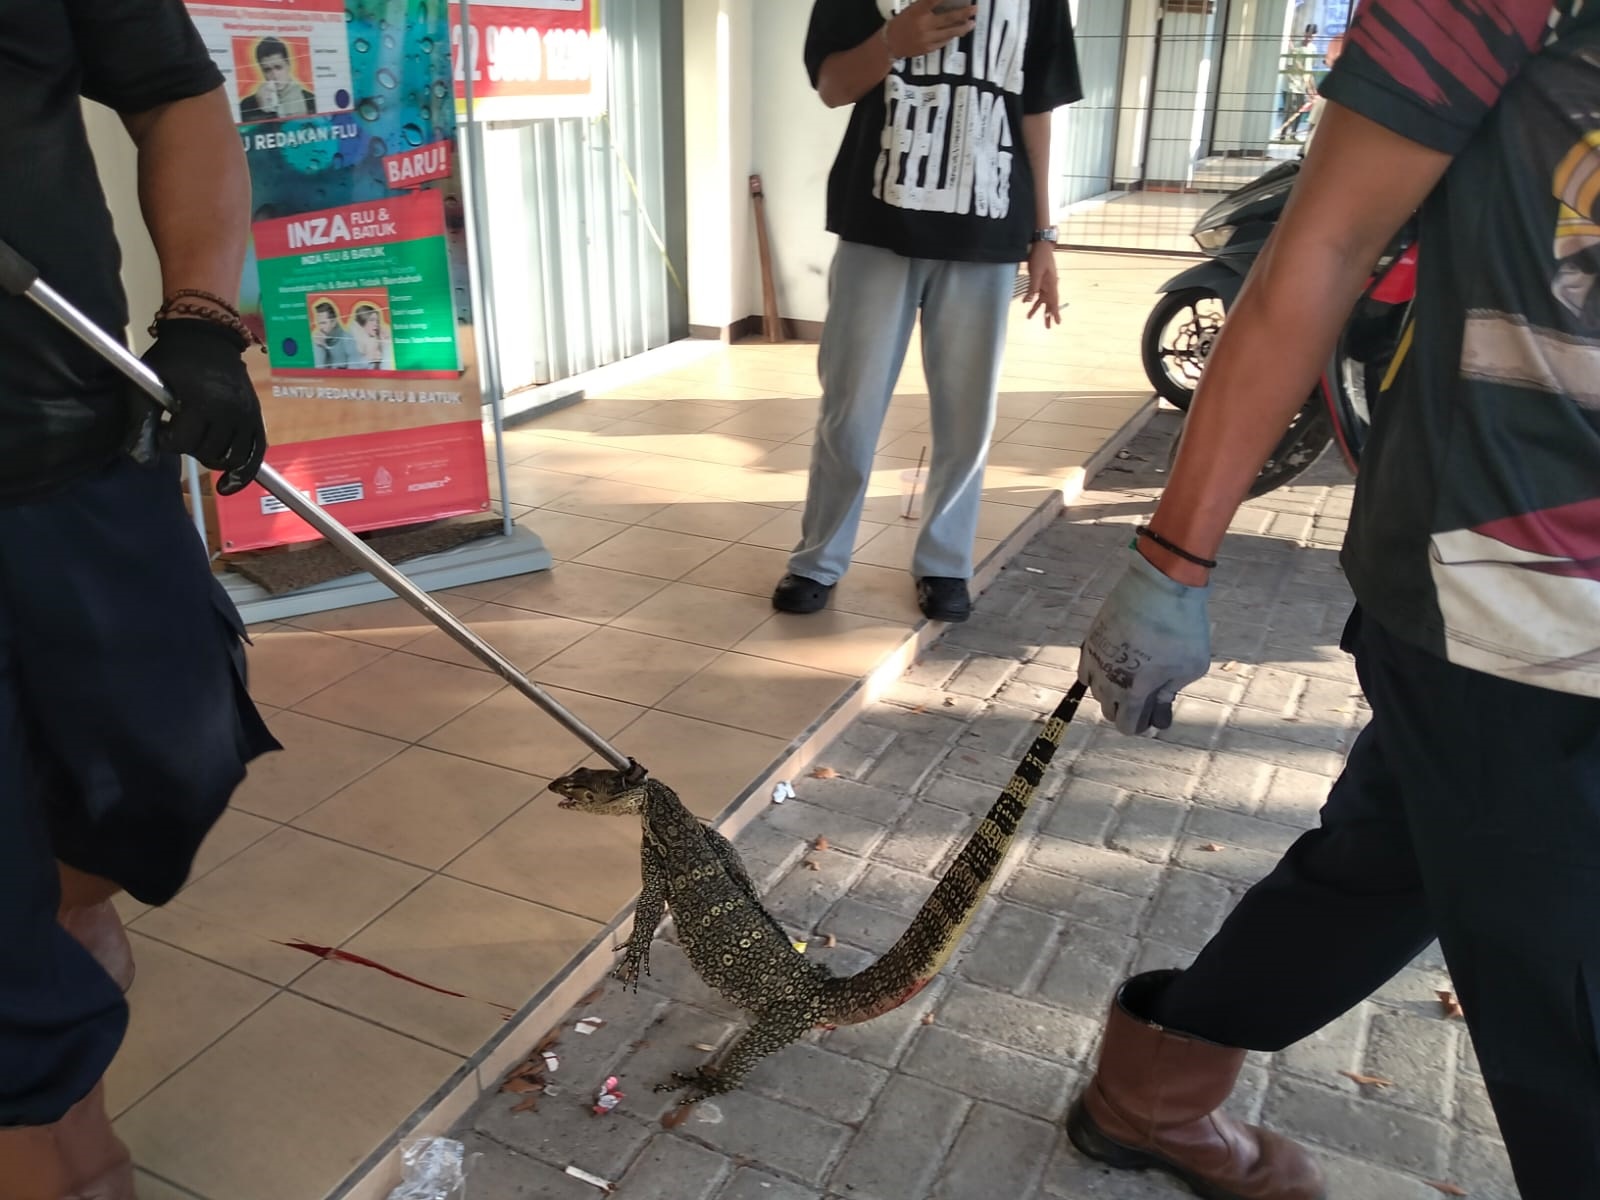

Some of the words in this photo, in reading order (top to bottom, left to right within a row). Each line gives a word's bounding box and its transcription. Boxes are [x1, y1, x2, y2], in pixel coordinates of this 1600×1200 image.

[254, 127, 328, 151] REDAKAN
[331, 124, 358, 140] FLU
[387, 147, 448, 183] BARU!
[351, 209, 376, 225] FLU
[378, 208, 390, 222] &
[287, 214, 351, 248] INZA
[351, 222, 398, 240] BATUK
[351, 247, 386, 260] BATUK
[272, 386, 314, 399] BANTU
[316, 387, 376, 401] REDAKAN
[379, 389, 405, 403] FLU
[418, 391, 463, 405] BATUK
